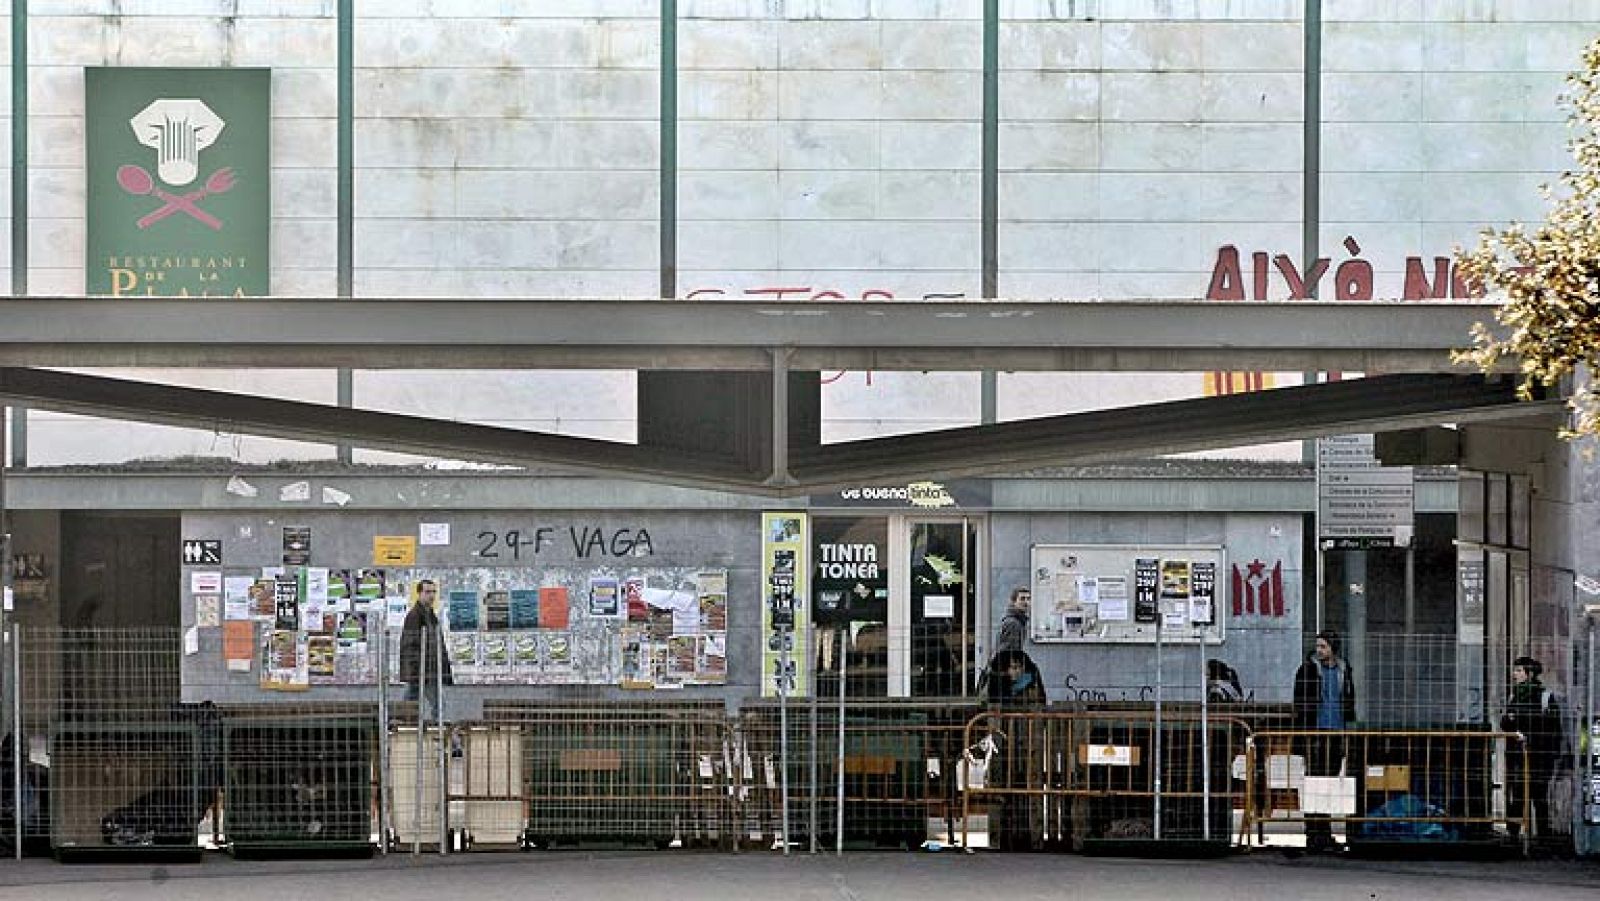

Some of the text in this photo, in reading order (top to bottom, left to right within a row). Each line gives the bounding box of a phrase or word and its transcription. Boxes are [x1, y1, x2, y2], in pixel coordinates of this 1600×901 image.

[108, 256, 247, 268] RESTAURANT
[145, 272, 219, 281] DE LA
[476, 525, 655, 560] 29-F VAGA
[820, 543, 877, 562] TINTA
[820, 562, 878, 579] TONER
